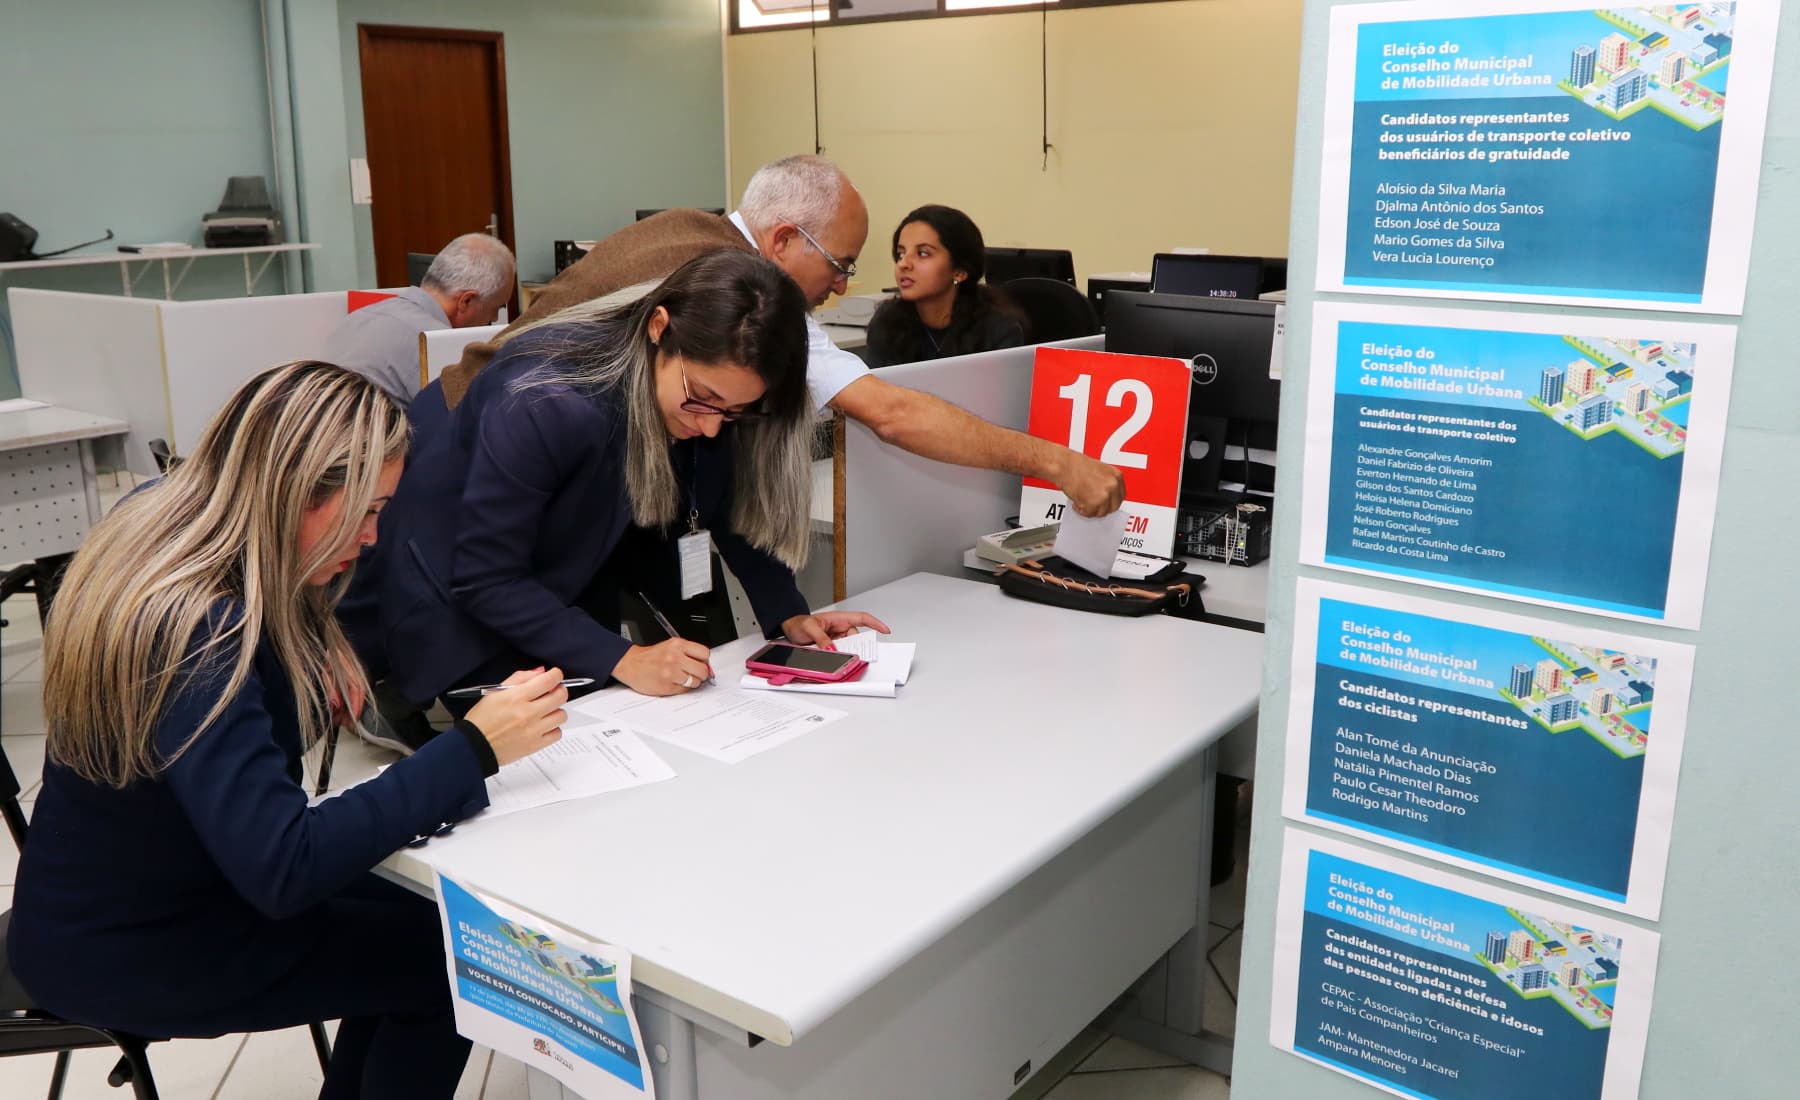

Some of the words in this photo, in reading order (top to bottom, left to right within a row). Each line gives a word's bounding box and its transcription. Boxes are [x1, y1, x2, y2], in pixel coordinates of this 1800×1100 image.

[1383, 42, 1436, 57] Eleição
[1438, 41, 1459, 54] do
[1382, 58, 1451, 73] Conselho
[1453, 54, 1533, 71] Municipal
[1381, 77, 1400, 89] de
[1403, 73, 1490, 88] Mobilidade
[1492, 72, 1552, 86] Urbana
[1380, 112, 1457, 125] Candidatos
[1459, 111, 1569, 127] representantes
[1379, 131, 1404, 143] dos
[1406, 130, 1464, 142] usuários
[1466, 129, 1485, 142] de
[1487, 130, 1566, 144] transporte
[1568, 128, 1631, 141] coletivo
[1378, 147, 1465, 160] beneficiários
[1467, 147, 1486, 160] de
[1488, 147, 1570, 163] gratuidade
[1419, 183, 1435, 195] da
[1438, 183, 1466, 195] Silva
[1469, 183, 1506, 196] Maria
[1375, 199, 1418, 213] Djalma
[1420, 200, 1470, 213] Antônio
[1472, 201, 1497, 213] dos
[1499, 201, 1544, 214] Santos
[1374, 216, 1411, 228] Edson
[1413, 218, 1441, 229] José
[1443, 218, 1459, 230] de
[1462, 218, 1500, 231] Souza
[1373, 233, 1408, 245] Mario
[1410, 234, 1454, 247] Gomes
[1456, 236, 1472, 248] da
[1475, 236, 1504, 249] Silva
[1372, 250, 1399, 262] Vera
[1401, 251, 1433, 263] Lucia
[1435, 252, 1494, 268] Lourenço
[1361, 343, 1413, 358] Eleição
[1415, 347, 1435, 359] do
[1192, 364, 1215, 374] DELL
[1361, 358, 1427, 375] Conselho
[1429, 364, 1504, 382] Municipal
[1359, 373, 1378, 386] de
[1381, 375, 1464, 394] Mobilidade
[1466, 383, 1523, 399] Urbana
[1058, 373, 1153, 470] 12
[1360, 406, 1416, 420] Candidatos
[1417, 414, 1496, 428] representantes
[1497, 420, 1517, 431] dos
[1359, 420, 1402, 431] usuários
[1403, 423, 1416, 432] de
[1417, 425, 1472, 438] transporte
[1473, 431, 1516, 443] coletivo
[1357, 455, 1386, 466] Daniel
[1423, 463, 1437, 473] de
[1437, 465, 1474, 477] Oliveira
[1358, 443, 1403, 456] Alexandre
[1404, 448, 1452, 462] Gonçalves
[1453, 454, 1492, 466] Amorim
[1356, 467, 1391, 479] Everton
[1392, 471, 1438, 485] Hernando
[1439, 478, 1452, 487] de
[1453, 480, 1477, 490] Lima
[1355, 479, 1384, 490] Gilson
[1384, 483, 1402, 493] dos
[1403, 485, 1434, 497] Santos
[1435, 489, 1474, 503] Cardozo
[1354, 503, 1374, 514] José
[1375, 506, 1412, 519] Roberto
[1412, 511, 1459, 526] Rodrigues
[1389, 495, 1420, 508] Helena
[1422, 500, 1472, 515] Domiciano
[1045, 503, 1066, 520] AT
[1124, 515, 1149, 535] EM
[1353, 515, 1384, 527] Nelson
[1385, 519, 1431, 534] Gonçalves
[1120, 536, 1144, 549] VIÇOS
[1351, 538, 1385, 551] Ricardo
[1385, 544, 1398, 554] da
[1399, 546, 1424, 558] Costa
[1426, 550, 1449, 562] Lima
[1352, 527, 1380, 538] Rafael
[1380, 531, 1415, 544] Martins
[1416, 536, 1459, 551] Coutinho
[1460, 543, 1473, 553] de
[1474, 545, 1505, 558] Castro
[1342, 620, 1390, 639] Eleição
[1392, 630, 1412, 643] do
[1340, 634, 1404, 656] Conselho
[1406, 647, 1477, 670] Municipal
[1339, 648, 1357, 661] de
[1359, 652, 1438, 678] Mobilidade
[1441, 668, 1494, 689] Urbana
[1338, 695, 1362, 709] dos
[1364, 702, 1417, 722] ciclistas
[1339, 679, 1415, 705] Candidatos
[1417, 698, 1528, 729] representantes
[1335, 741, 1380, 762] Daniela
[1383, 753, 1441, 777] Machado
[1443, 768, 1471, 784] Dias
[1336, 727, 1363, 742] Alan
[1365, 733, 1399, 751] Tomé
[1401, 742, 1417, 755] da
[1420, 747, 1496, 774] Anunciação
[1334, 757, 1375, 776] Natália
[1378, 767, 1432, 791] Pimentel
[1435, 782, 1479, 803] Ramos
[1332, 787, 1379, 809] Rodrigo
[1382, 800, 1428, 822] Martins
[1333, 772, 1366, 789] Paulo
[1368, 782, 1402, 799] Cesar
[1404, 790, 1466, 815] Theodoro
[1329, 873, 1374, 895] Eleição
[1376, 888, 1393, 900] do
[1328, 886, 1386, 912] Conselho
[1388, 905, 1454, 933] Municipal
[1327, 899, 1343, 912] de
[1345, 905, 1418, 936] Mobilidade
[1420, 928, 1470, 952] Urbana
[461, 934, 518, 966] Conselho
[506, 944, 521, 957] do
[1326, 928, 1391, 957] Candidatos
[1393, 951, 1486, 987] representantes
[463, 948, 478, 960] de
[481, 954, 553, 995] Mobilidade
[1324, 942, 1345, 956] das
[1347, 951, 1405, 976] entidades
[1407, 968, 1451, 991] ligadas
[1453, 986, 1462, 995] a
[1464, 988, 1506, 1009] defesa
[1321, 982, 1355, 1001] CEPAC
[1363, 996, 1423, 1024] Associação
[1323, 956, 1344, 970] das
[1345, 964, 1392, 986] pessoas
[1393, 981, 1419, 995] com
[1421, 988, 1488, 1018] deficiência
[1490, 1013, 1498, 1021] e
[1500, 1013, 1543, 1036] idosos
[1320, 996, 1334, 1007] de
[1336, 1000, 1356, 1015] Pais
[1358, 1008, 1437, 1043] Companheiros
[1318, 1034, 1358, 1056] Ampara
[1360, 1049, 1406, 1074] Menores
[1347, 1031, 1418, 1064] Mantenedora
